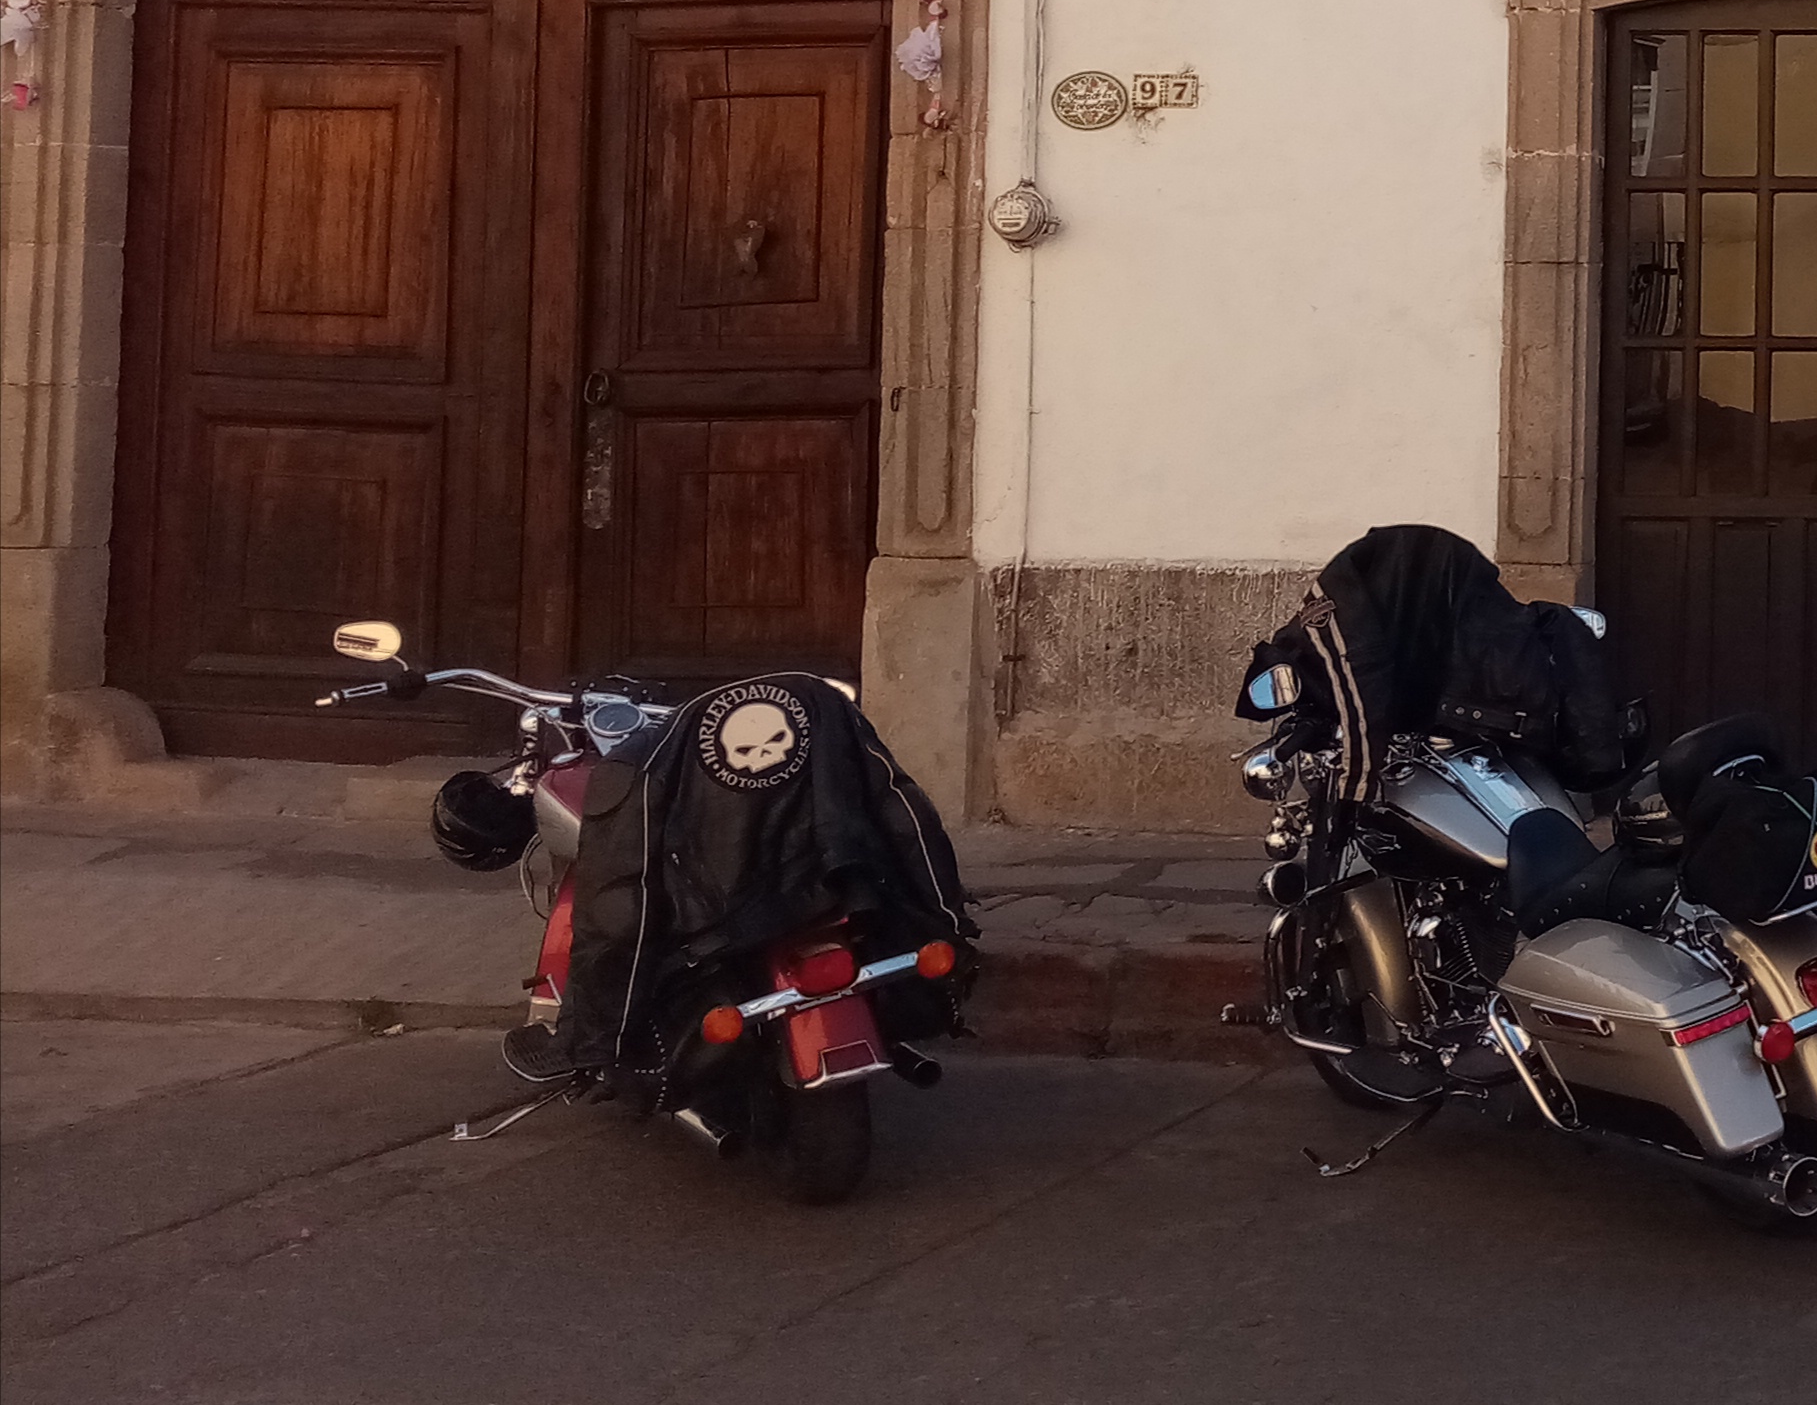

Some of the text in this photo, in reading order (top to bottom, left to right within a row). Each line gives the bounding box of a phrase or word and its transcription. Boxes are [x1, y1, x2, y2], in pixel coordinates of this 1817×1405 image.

[1140, 80, 1188, 101] 97
[699, 684, 811, 766] HARLEY-DAVIDSON
[715, 737, 811, 789] MOTORCYCLES
